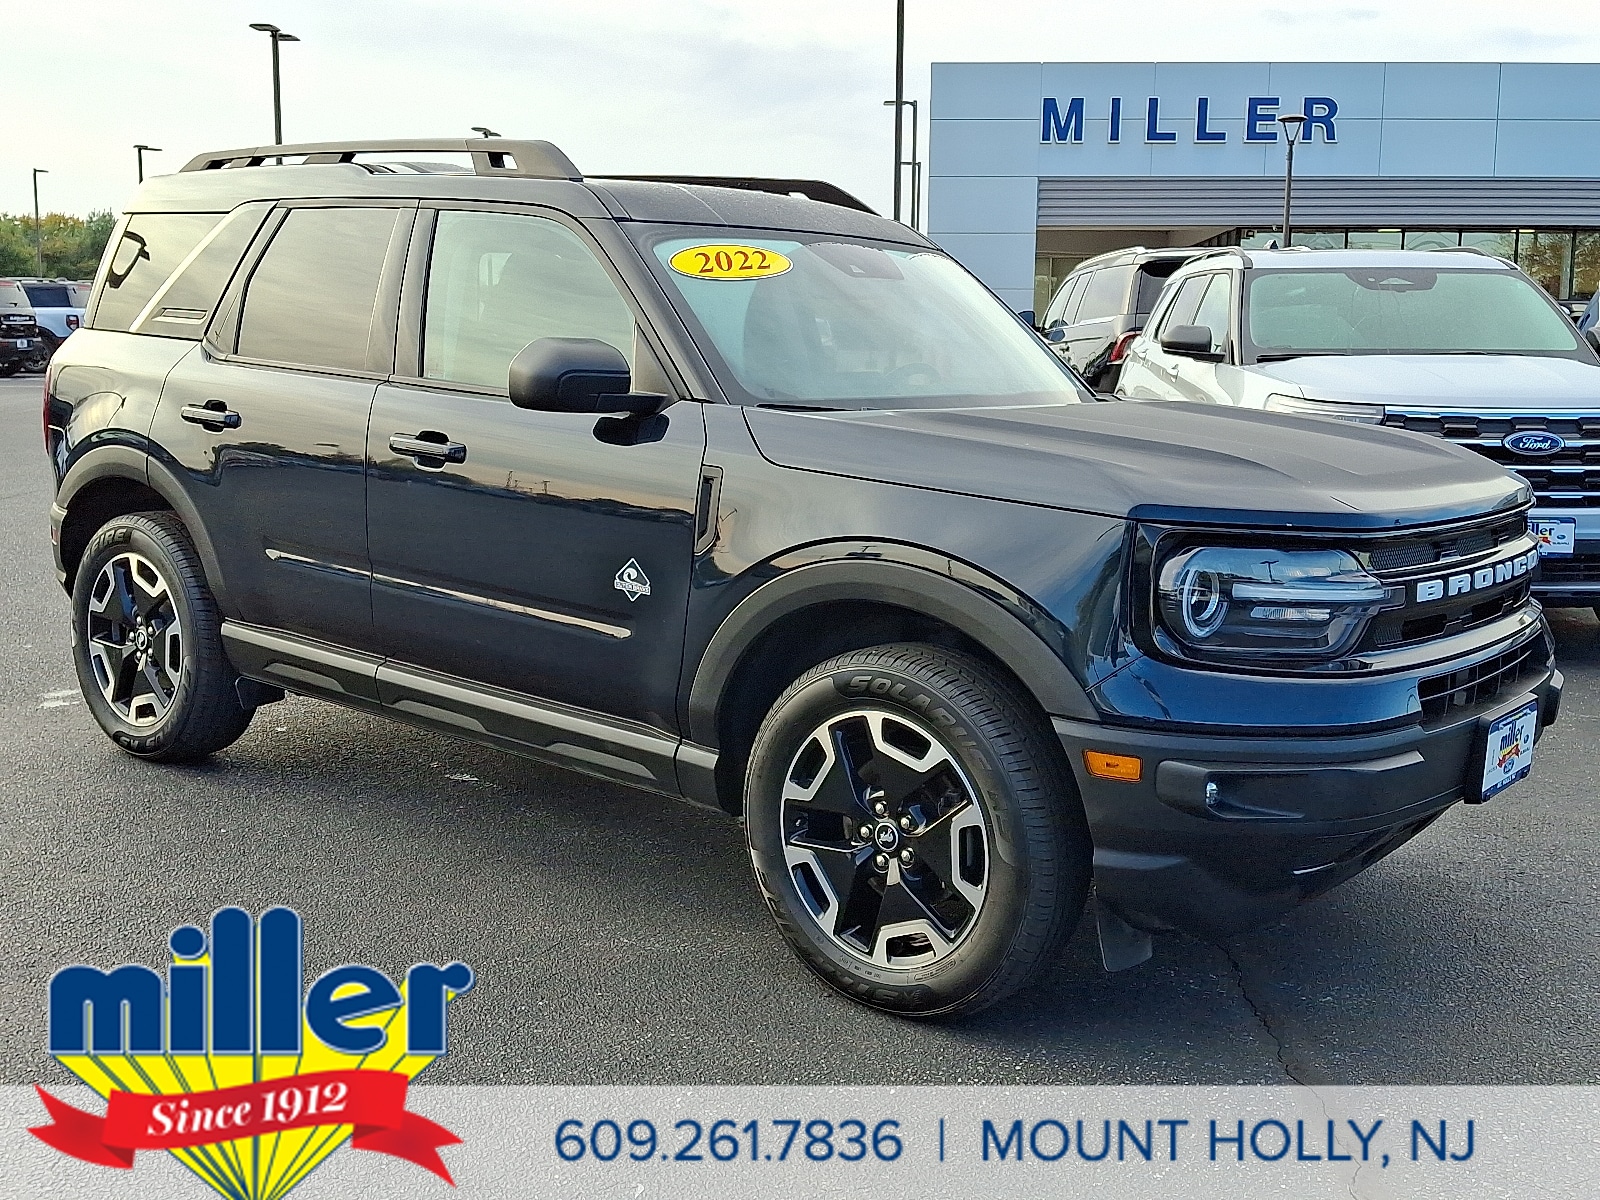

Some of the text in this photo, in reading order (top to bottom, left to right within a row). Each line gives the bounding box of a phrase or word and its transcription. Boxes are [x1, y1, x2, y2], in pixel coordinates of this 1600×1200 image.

[1040, 96, 1339, 144] MILLER
[694, 250, 771, 274] 2022
[1519, 435, 1552, 451] Ford
[1416, 549, 1539, 602] BRONCO
[1500, 720, 1525, 752] miller
